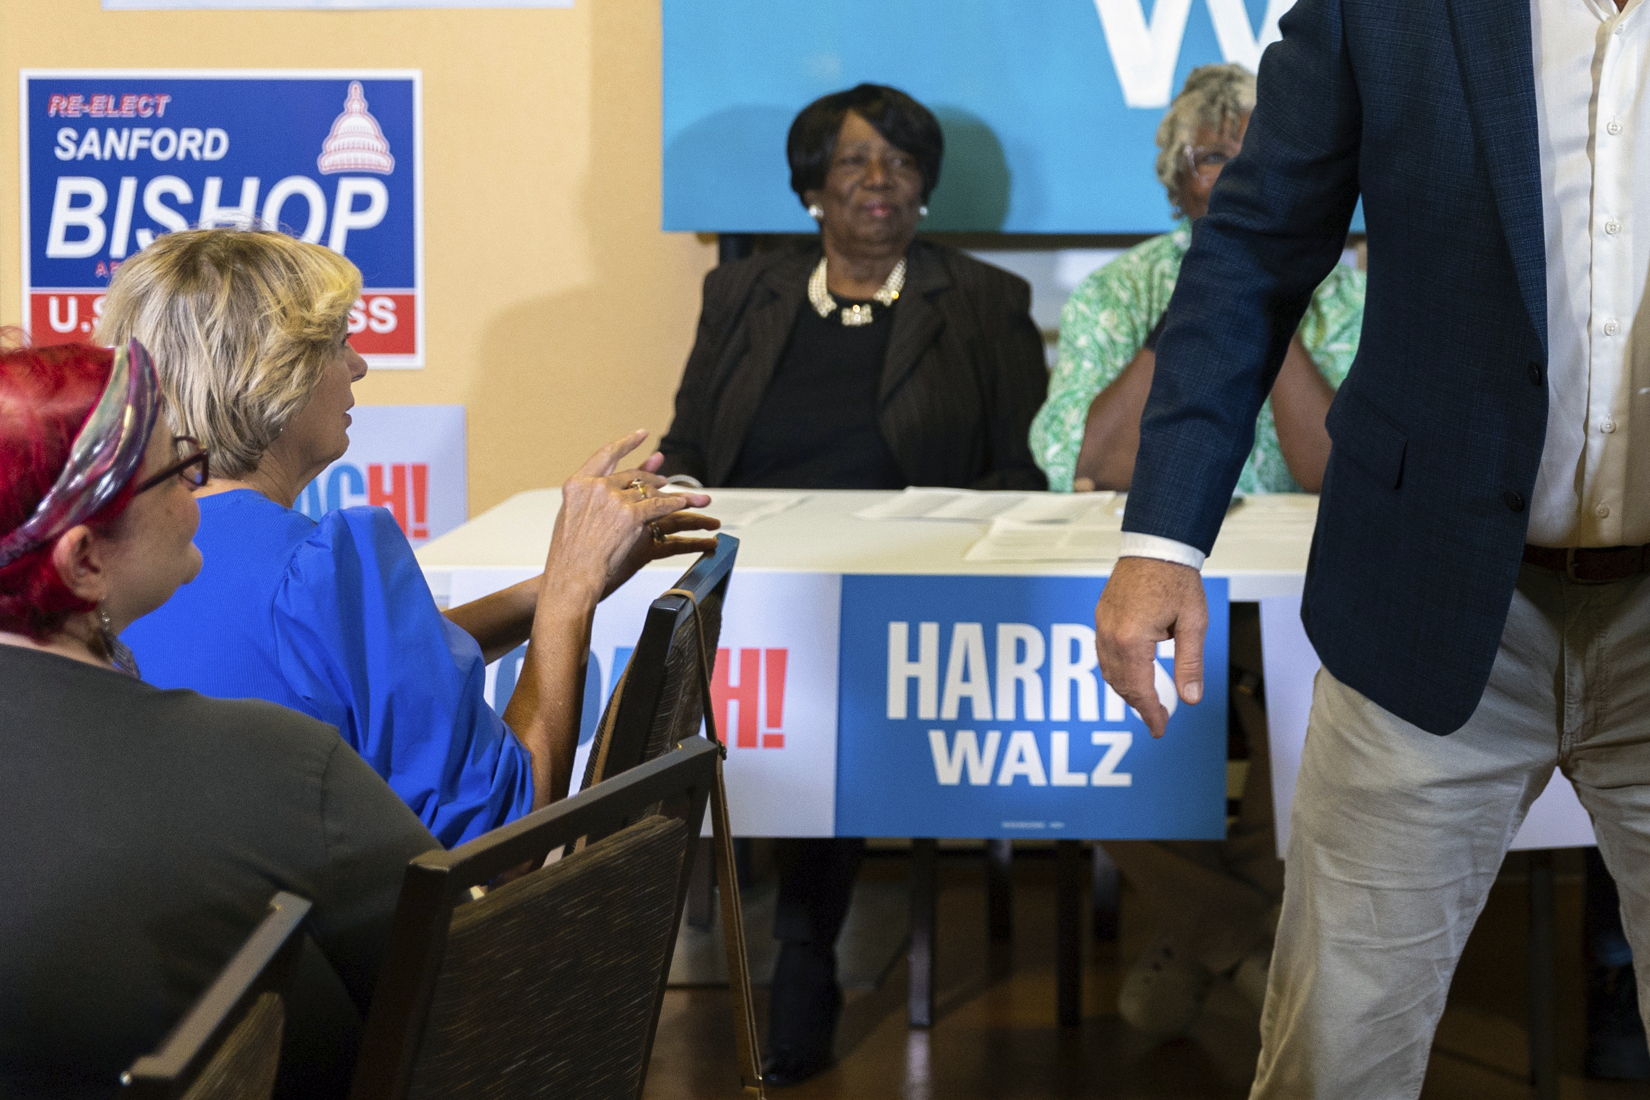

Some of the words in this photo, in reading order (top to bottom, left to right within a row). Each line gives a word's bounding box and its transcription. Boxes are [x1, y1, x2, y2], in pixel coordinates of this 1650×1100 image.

[47, 93, 172, 118] RE-ELECT
[53, 127, 230, 162] SANFORD
[46, 175, 390, 259] BISHOP
[928, 728, 1133, 788] WALZ
